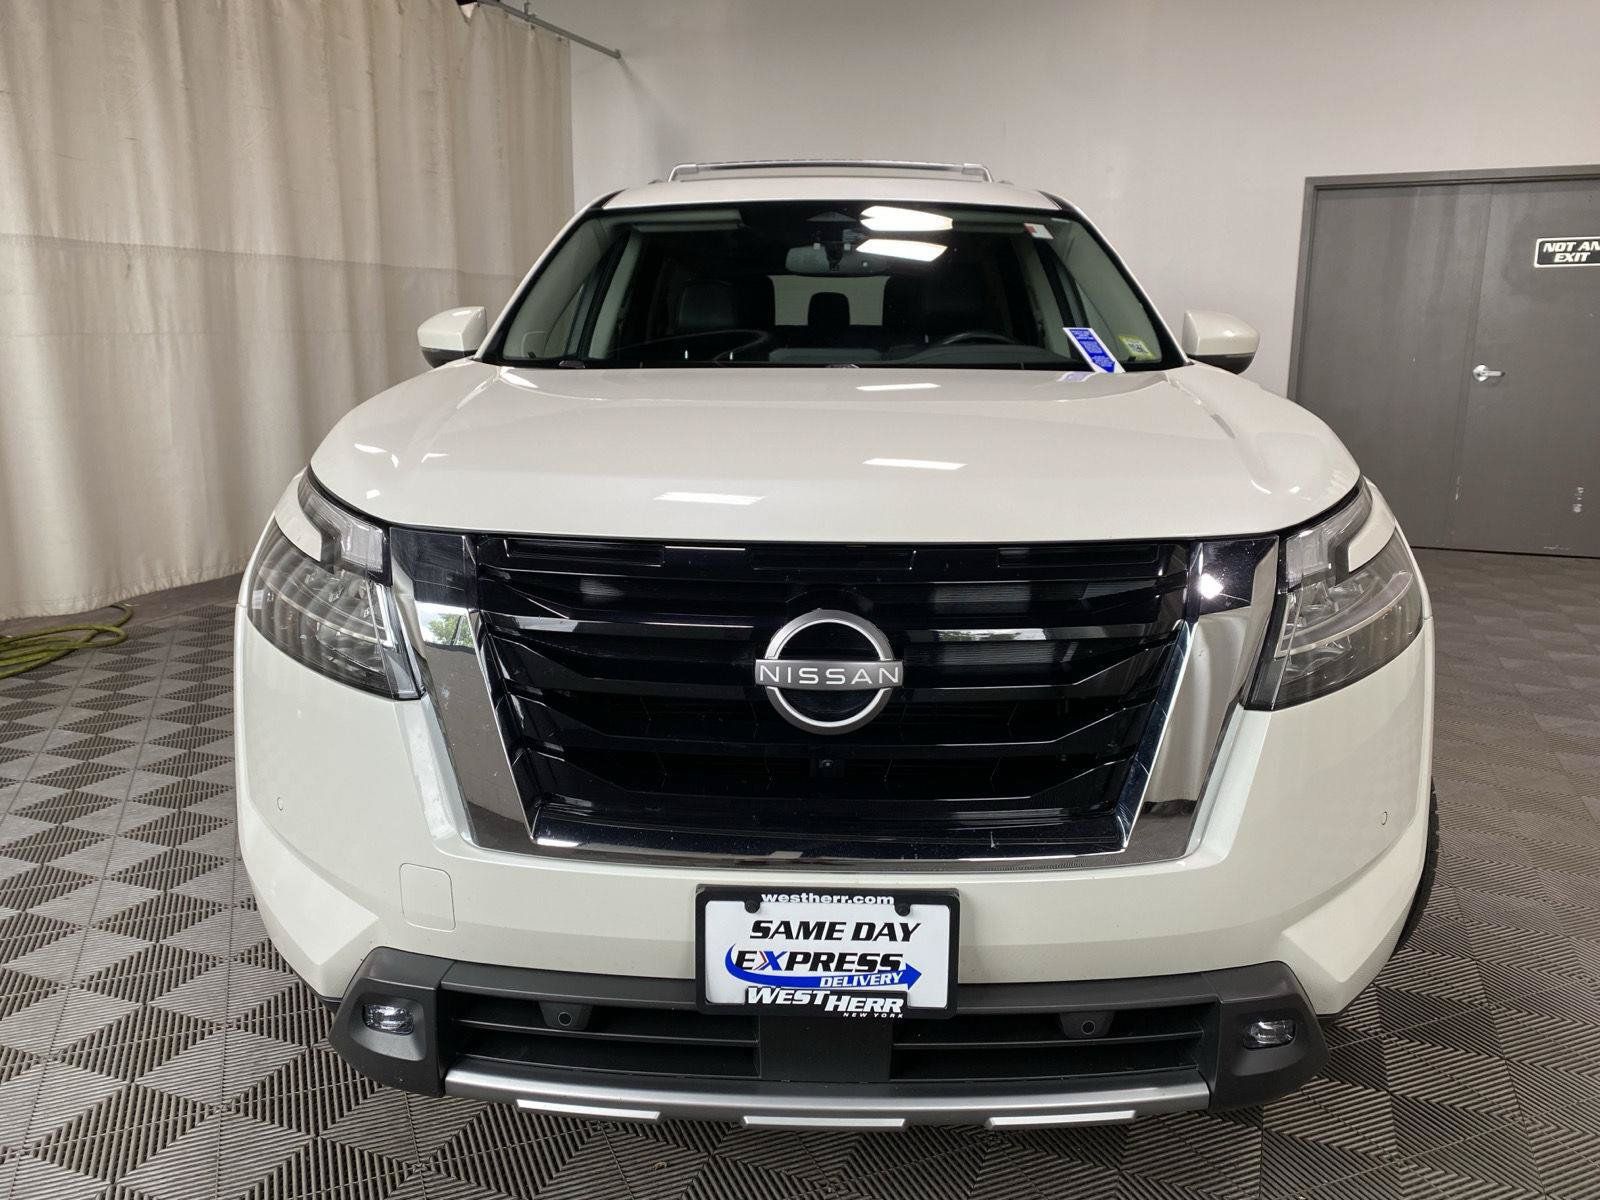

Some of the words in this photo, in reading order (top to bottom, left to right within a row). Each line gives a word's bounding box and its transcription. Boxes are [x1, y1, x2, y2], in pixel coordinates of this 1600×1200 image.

[1542, 242, 1576, 253] NOT
[1553, 252, 1591, 263] EXIT
[759, 665, 899, 685] NISSAN
[761, 892, 895, 905] westherr.com
[750, 919, 847, 941] SAME
[850, 921, 922, 942] DAY
[734, 950, 904, 973] EXPRESS
[819, 971, 903, 989] DELIVERY
[873, 1011, 904, 1019] YORK
